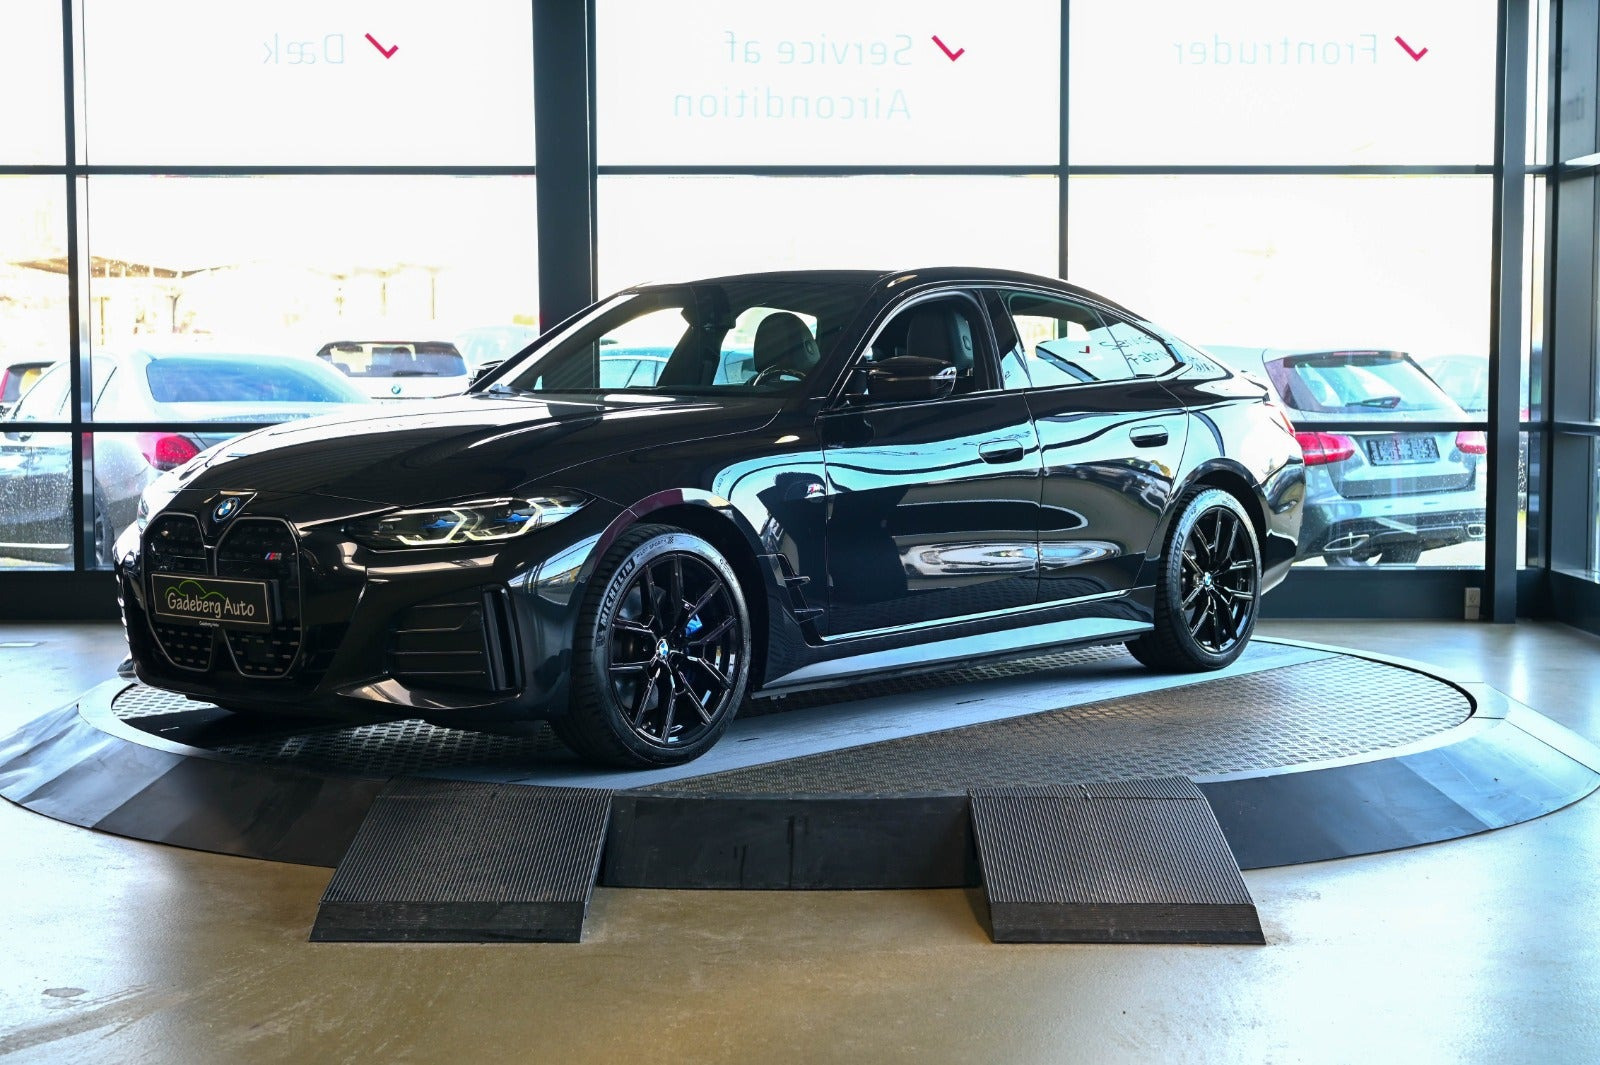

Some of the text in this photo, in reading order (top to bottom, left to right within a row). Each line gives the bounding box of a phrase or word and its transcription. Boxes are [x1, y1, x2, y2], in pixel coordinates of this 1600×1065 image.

[167, 592, 255, 618] Gadeberg Auto
[600, 561, 633, 627] MICHELIN
